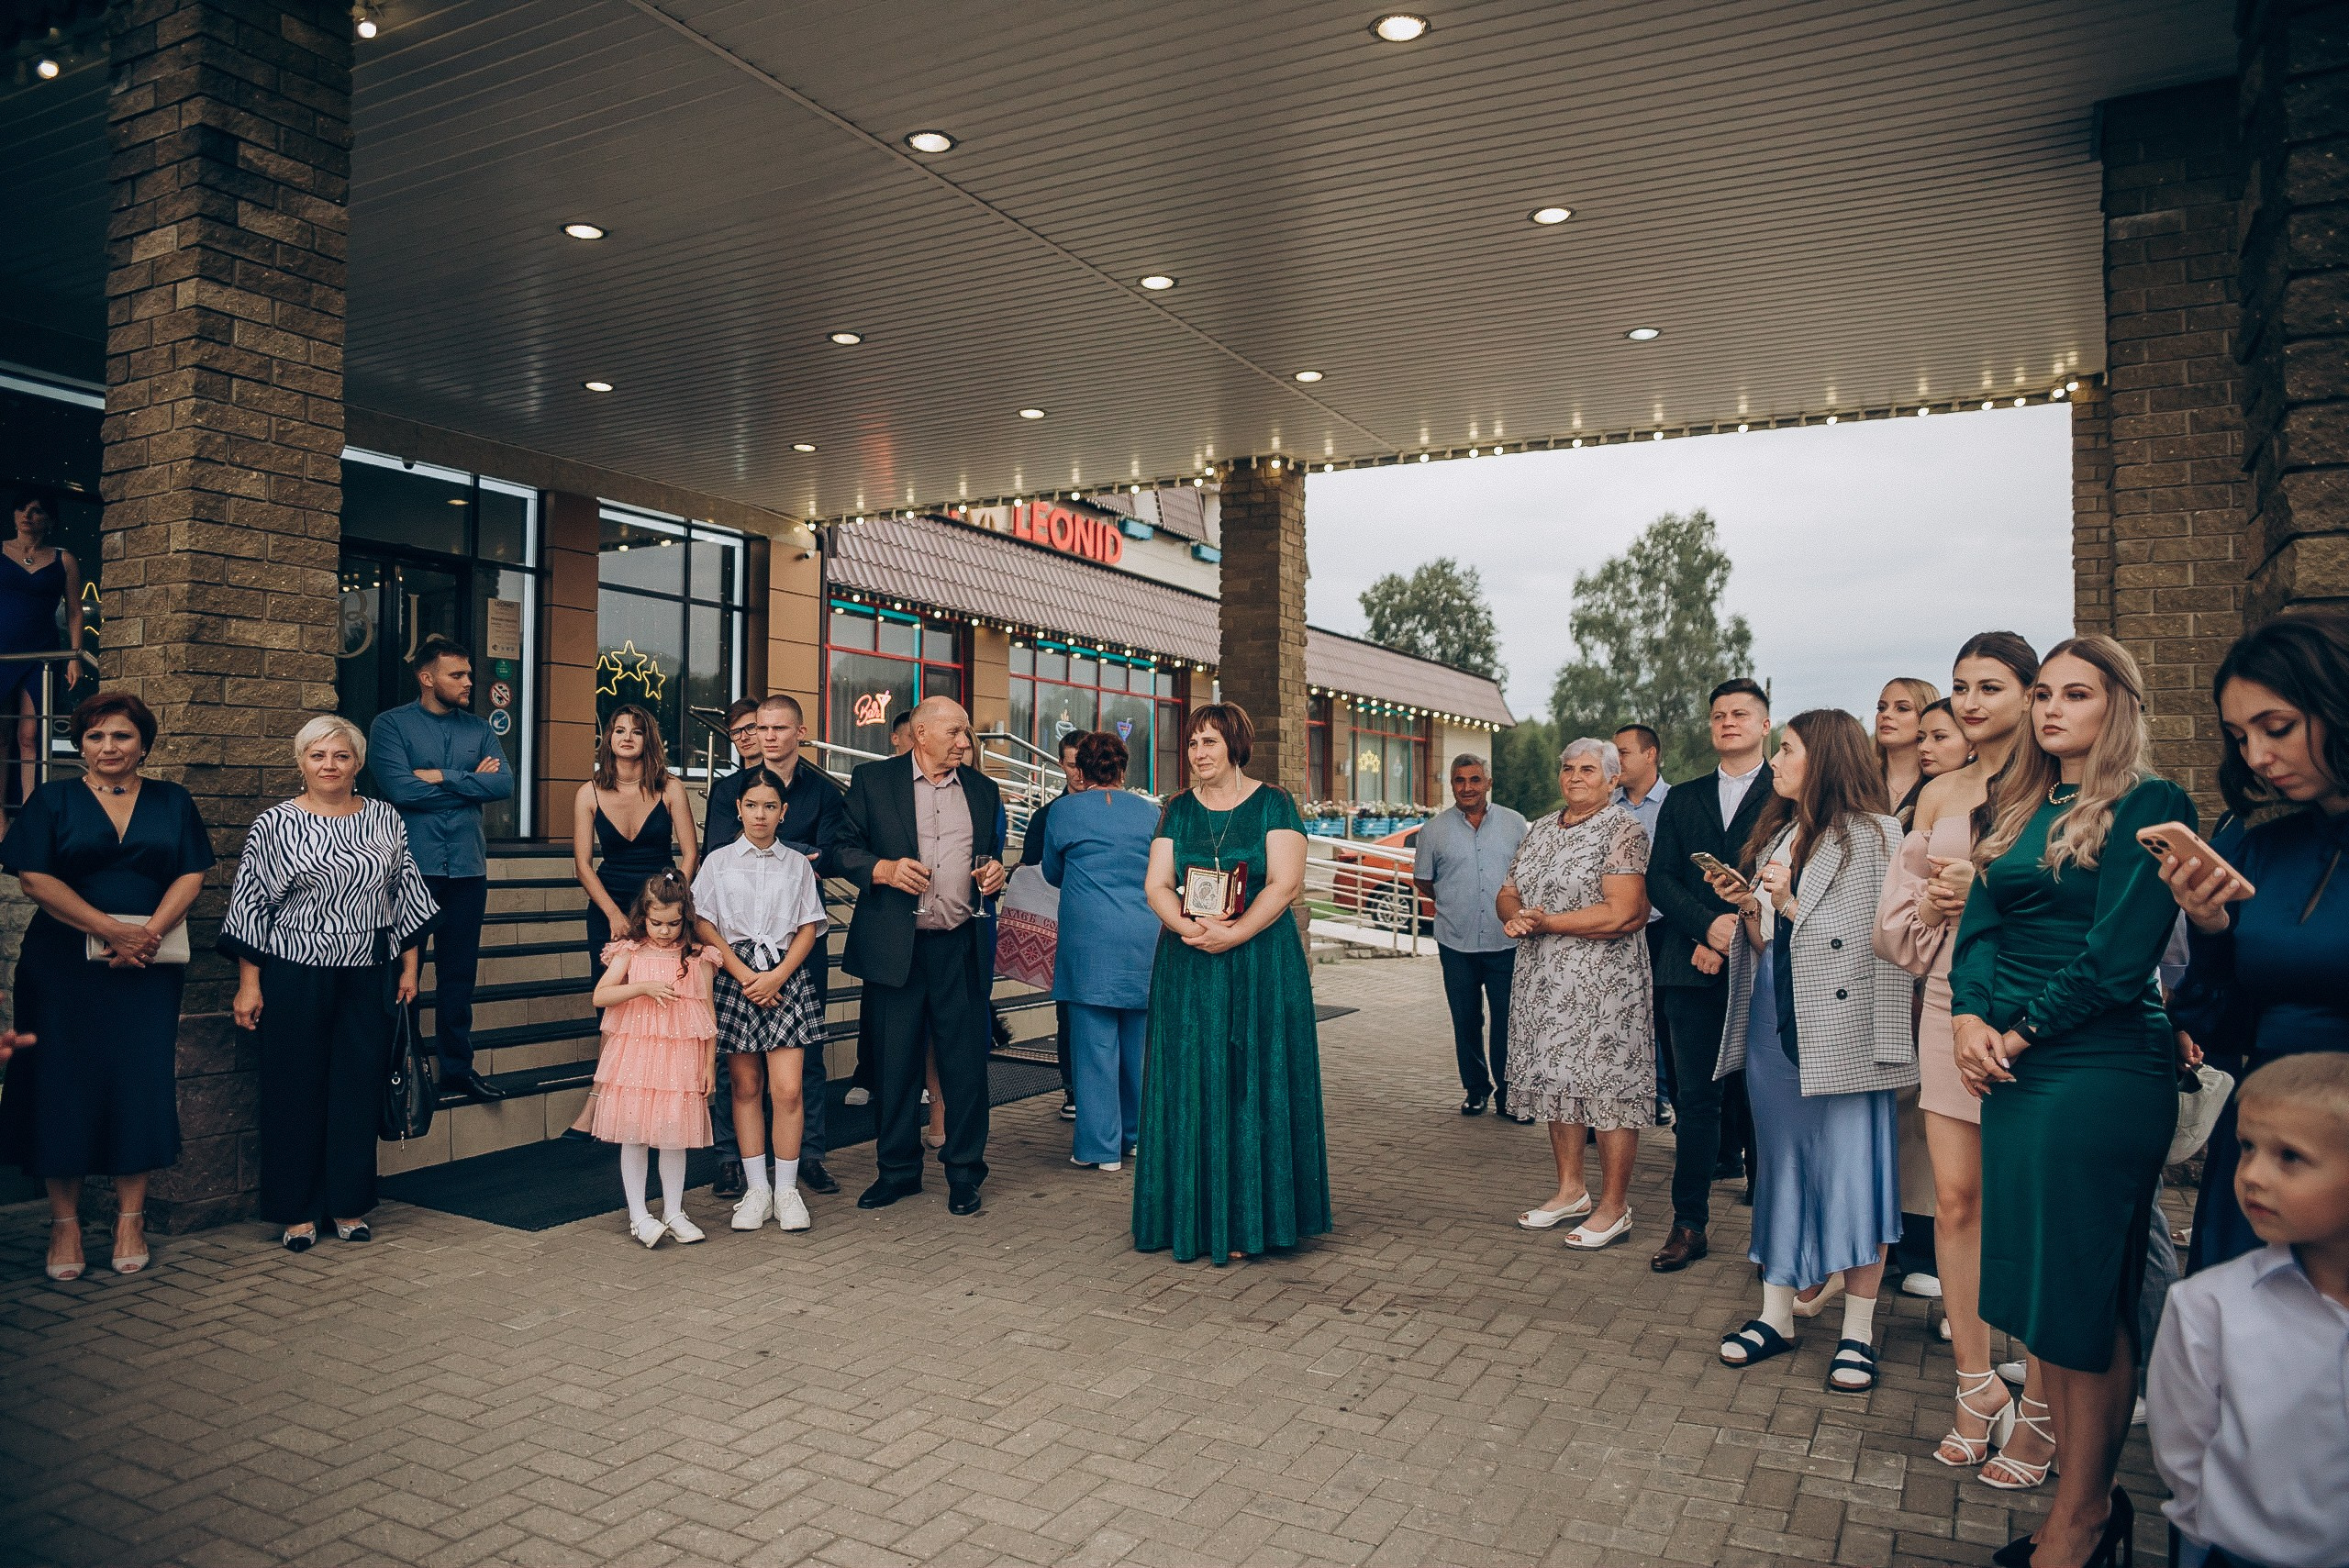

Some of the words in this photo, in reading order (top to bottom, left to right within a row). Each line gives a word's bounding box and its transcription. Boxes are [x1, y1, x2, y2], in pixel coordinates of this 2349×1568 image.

[1013, 502, 1122, 565] LEONID
[854, 694, 881, 727] Bar
[1042, 917, 1058, 931] СО
